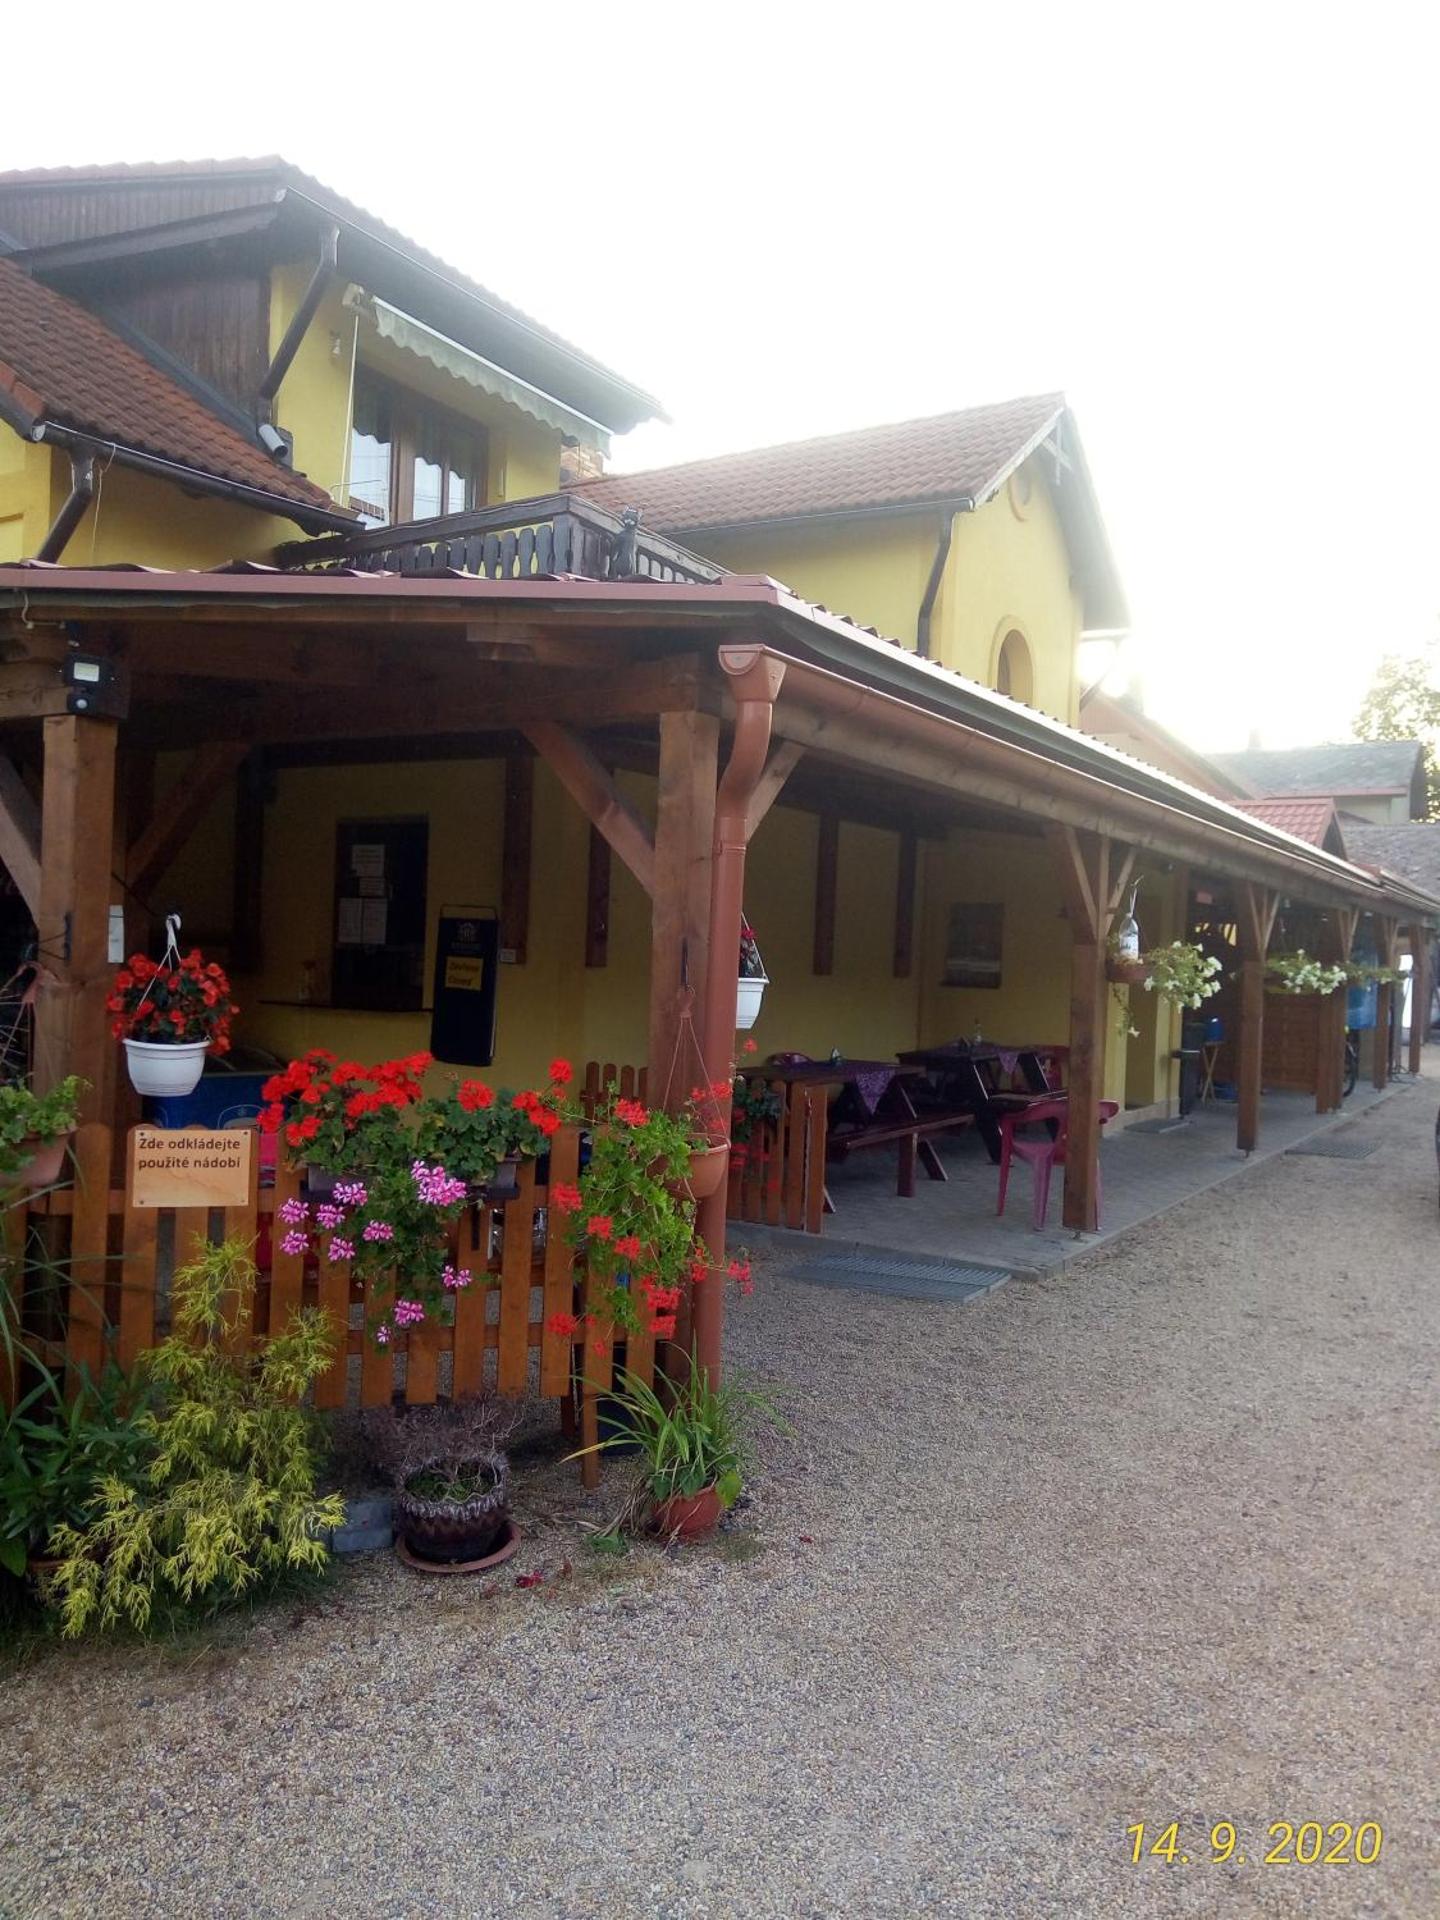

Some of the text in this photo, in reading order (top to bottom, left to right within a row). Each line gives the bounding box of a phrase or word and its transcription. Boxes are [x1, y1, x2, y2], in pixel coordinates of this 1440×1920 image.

[139, 1138, 240, 1152] Zde odkládejte
[138, 1156, 240, 1170] použité nádobí
